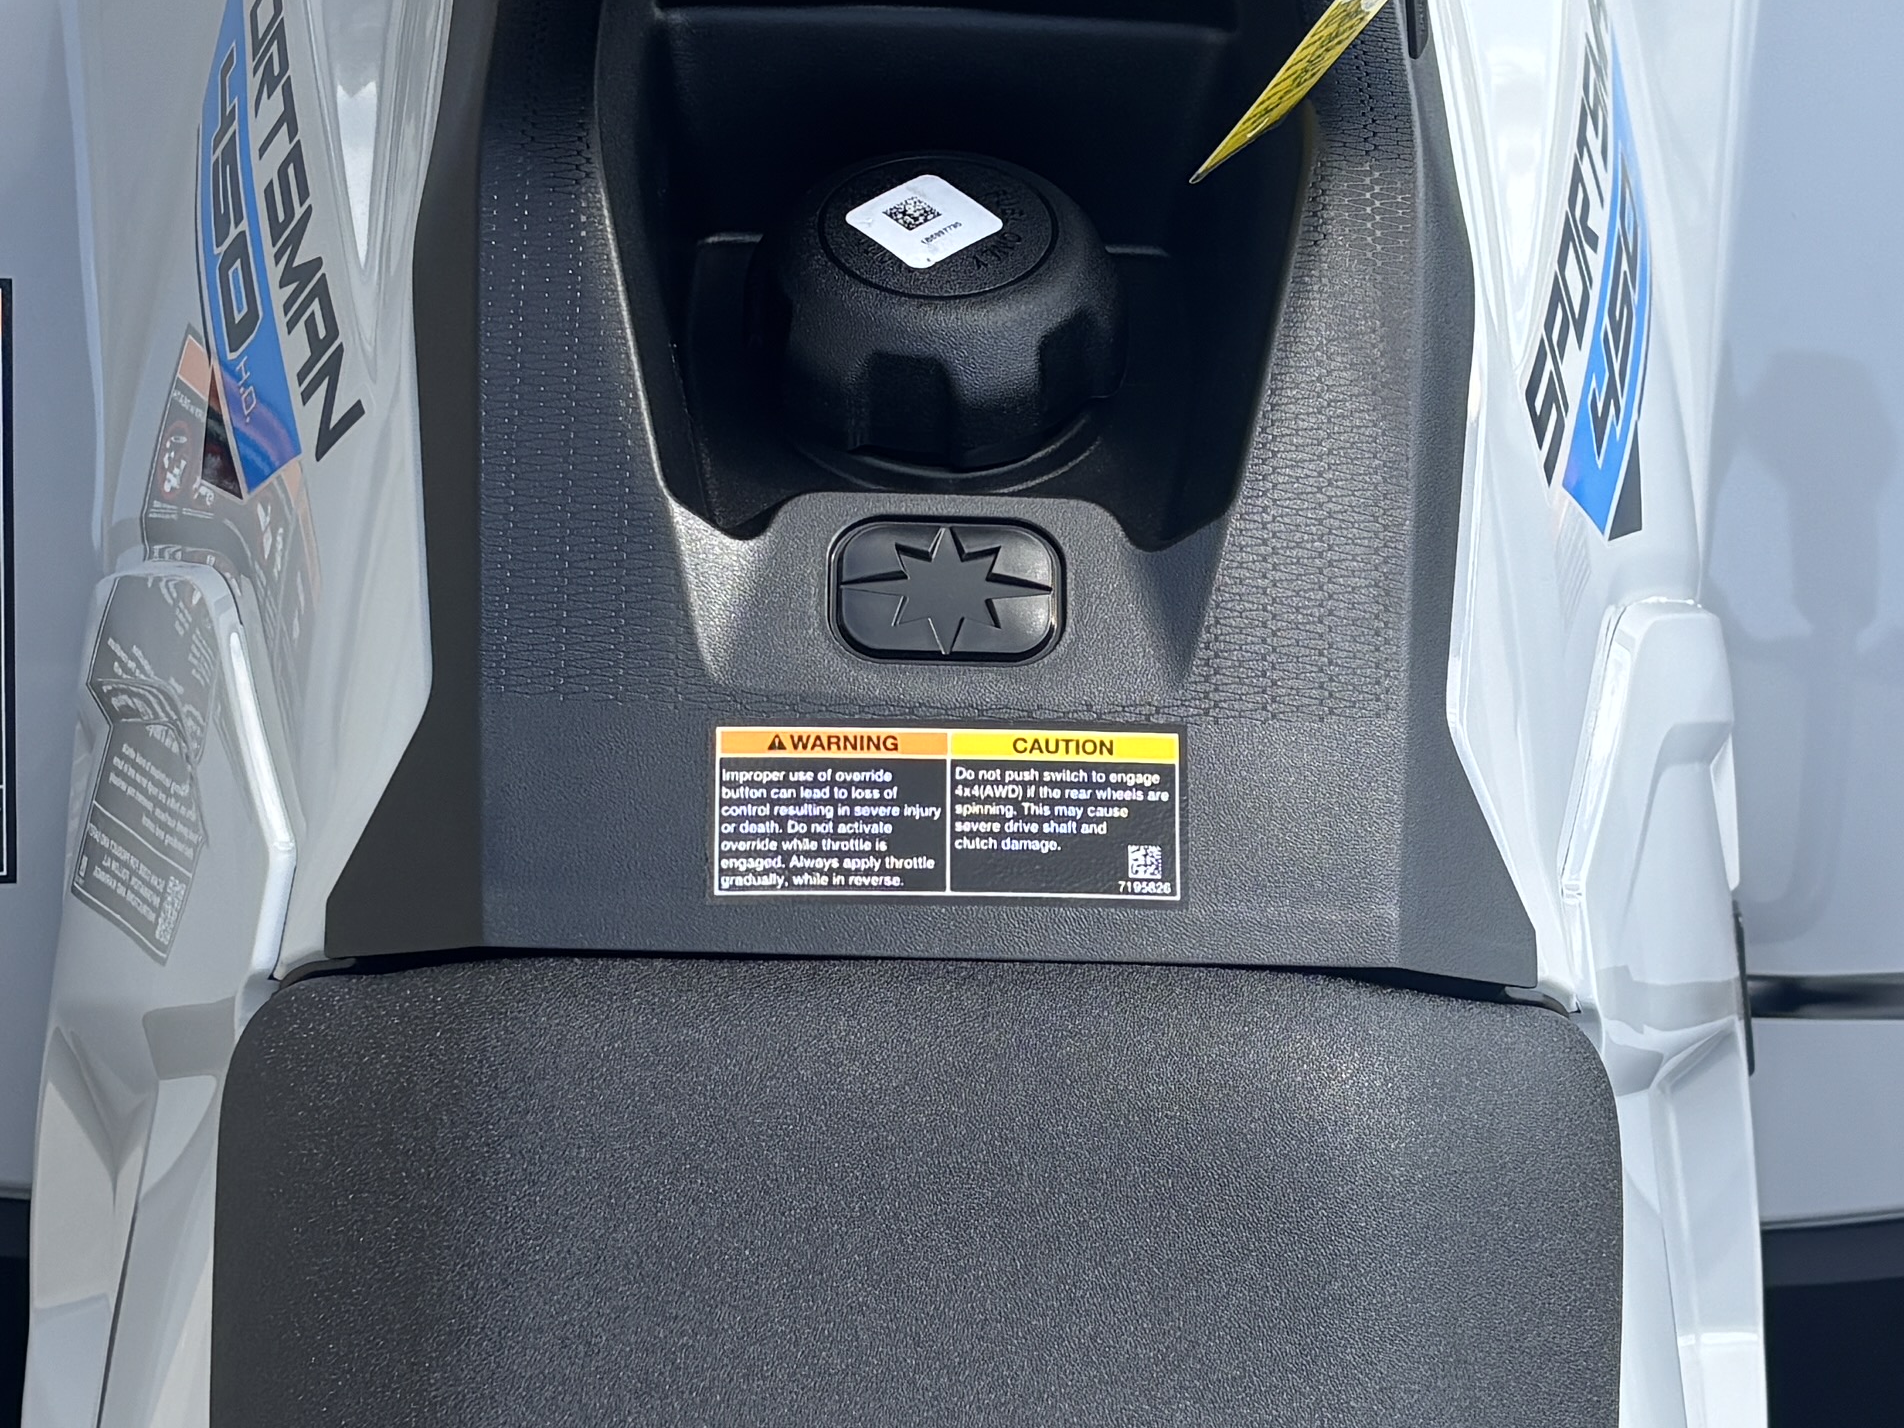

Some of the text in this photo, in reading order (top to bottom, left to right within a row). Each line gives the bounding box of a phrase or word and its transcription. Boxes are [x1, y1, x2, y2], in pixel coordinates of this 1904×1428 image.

[211, 42, 262, 358] 450
[789, 734, 898, 752] WARNING
[1012, 737, 1114, 756] CAUTION
[722, 768, 893, 785] Improper use of override
[955, 766, 1161, 787] Do not push switch to engage
